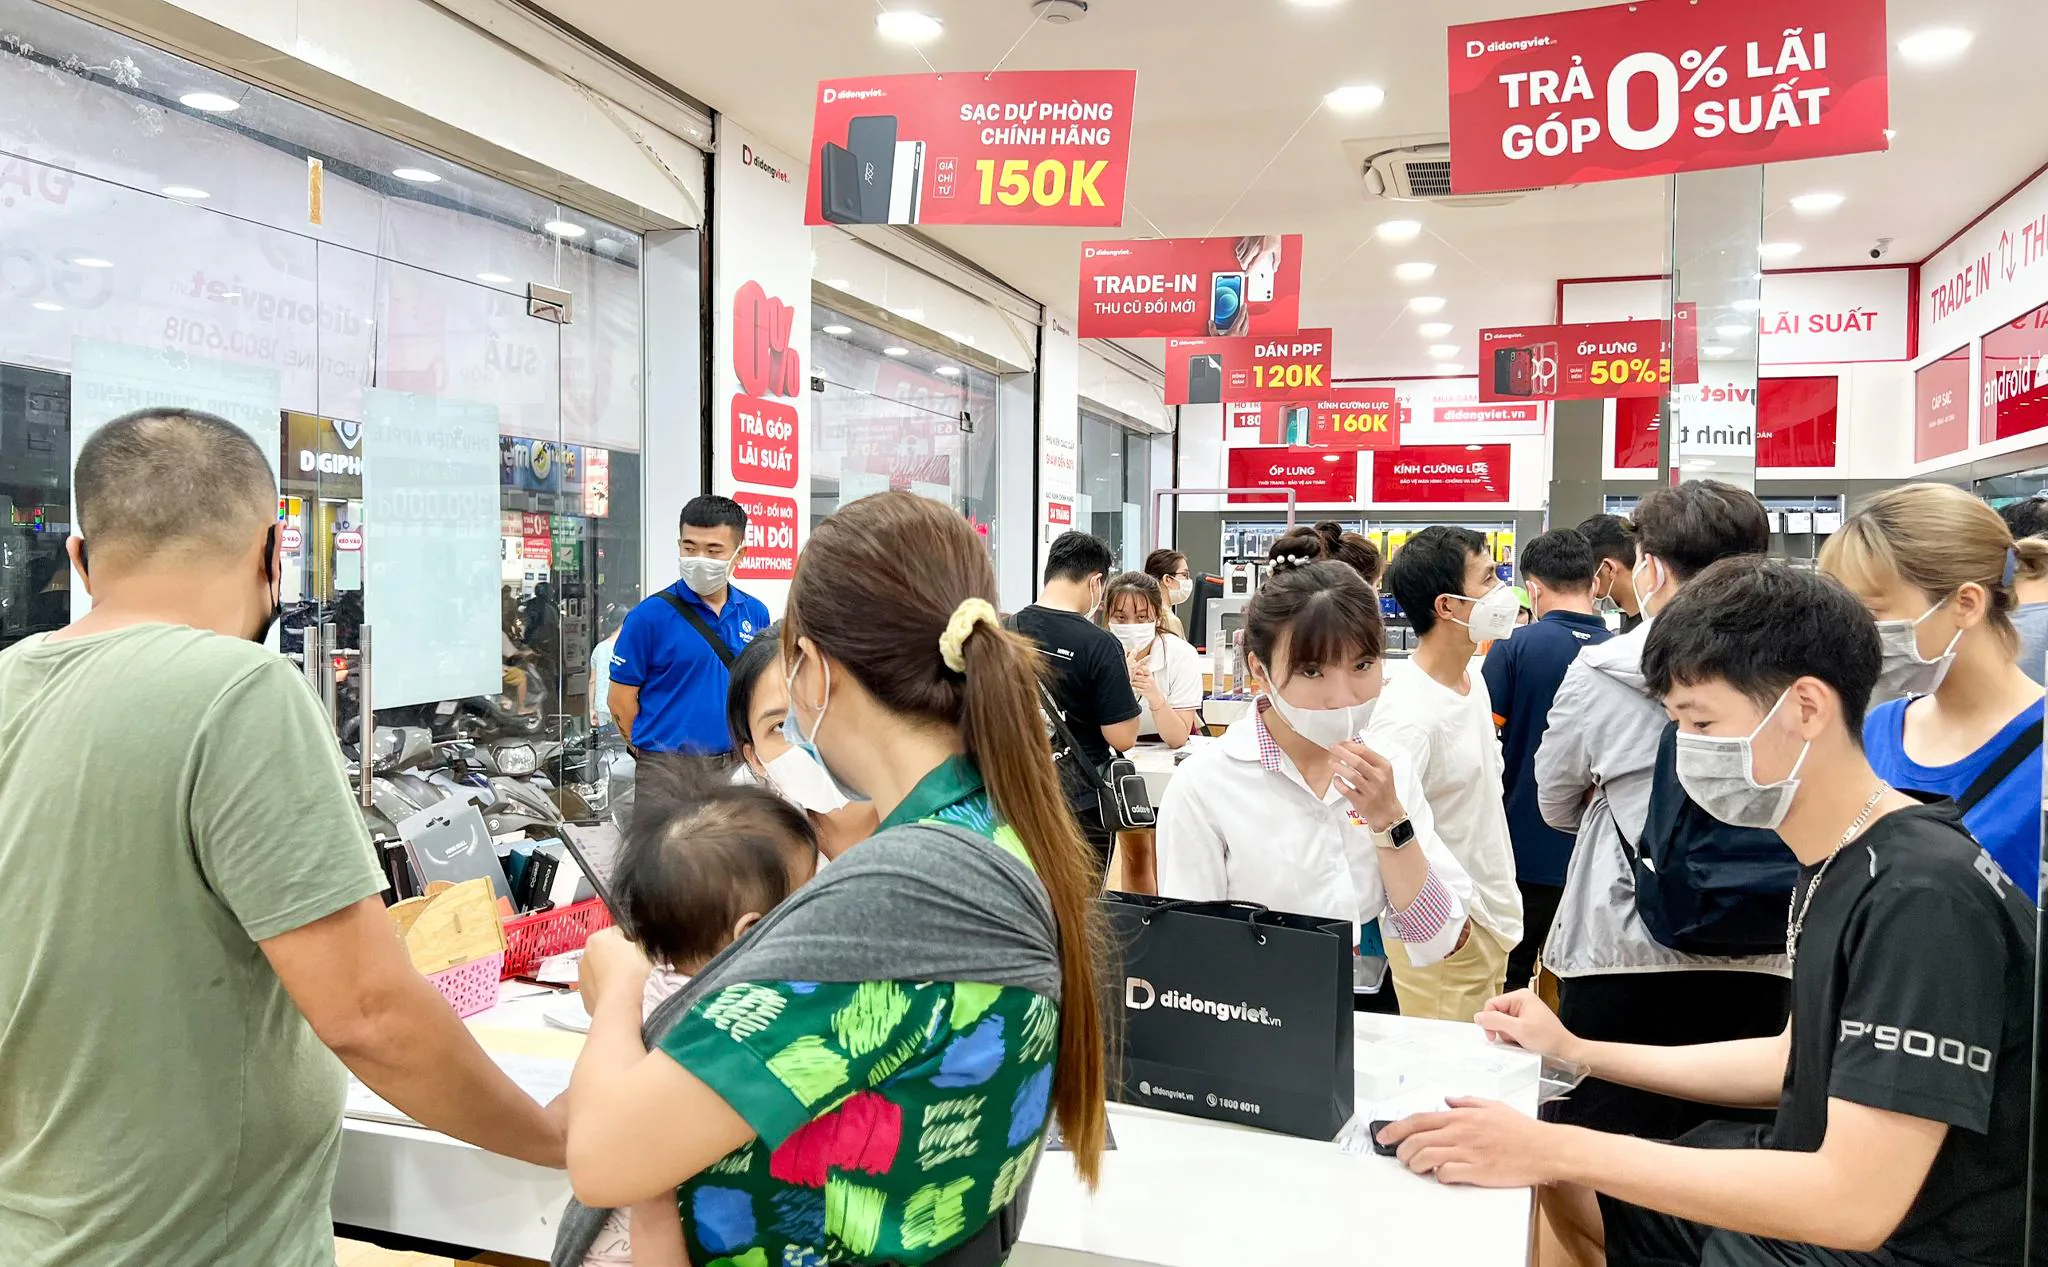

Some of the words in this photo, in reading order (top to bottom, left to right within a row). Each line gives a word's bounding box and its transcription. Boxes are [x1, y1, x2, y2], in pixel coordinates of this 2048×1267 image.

[1498, 55, 1595, 109] TRẢ
[1746, 27, 1826, 79] LÃI
[960, 103, 1000, 125] SẠC
[1004, 100, 1037, 125] DỰ
[1039, 99, 1113, 121] PHÒNG
[1502, 111, 1601, 160] GÓP
[1693, 77, 1830, 138] SUẤT
[981, 123, 1046, 145] CHÍNH
[1050, 125, 1111, 146] HÃNG
[939, 160, 954, 170] GIÁ
[975, 158, 1109, 207] 150K
[1931, 265, 1972, 324] TRADE
[1975, 252, 1990, 297] IN
[2022, 214, 2048, 267] TH
[1093, 274, 1197, 294] TRADE-IN
[1094, 301, 1120, 314] THU
[1123, 299, 1141, 313] CŨ
[1144, 297, 1167, 313] ĐỔI
[1170, 299, 1196, 313] MỚI
[1760, 311, 1799, 335] LÃI
[1808, 306, 1878, 334] SUẤT
[1254, 342, 1288, 358] DÁN
[1292, 343, 1323, 357] PPF
[1577, 340, 1596, 355] ỐP
[1599, 342, 1637, 355] LƯNG
[1253, 364, 1323, 388] 120K
[1589, 358, 1656, 385] 50%
[1984, 354, 2031, 408] android
[1317, 400, 1338, 410] KÍNH
[1340, 400, 1370, 410] CƯỜNG
[1372, 400, 1389, 411] LỰC
[1444, 408, 1525, 422] didongviet.vn
[738, 411, 764, 436] TRẢ
[766, 417, 792, 440] GÓP
[1331, 413, 1389, 432] 160K
[300, 450, 363, 476] DIGIPH
[738, 441, 758, 466] LÃI
[760, 445, 793, 471] SUẤT
[1286, 465, 1316, 476] LƯNG
[1393, 463, 1420, 474] KÍNH
[1422, 462, 1464, 474] CƯỜNG
[753, 502, 763, 516] CŨ
[744, 518, 764, 547] ÊN
[767, 521, 793, 549] ĐỜI
[737, 555, 793, 571] SMARTPHONE
[1160, 990, 1282, 1027] didongviet.vn
[1839, 1018, 1993, 1074] P'9000
[1152, 1085, 1194, 1101] didongviet.vn
[1219, 1096, 1238, 1111] 1800
